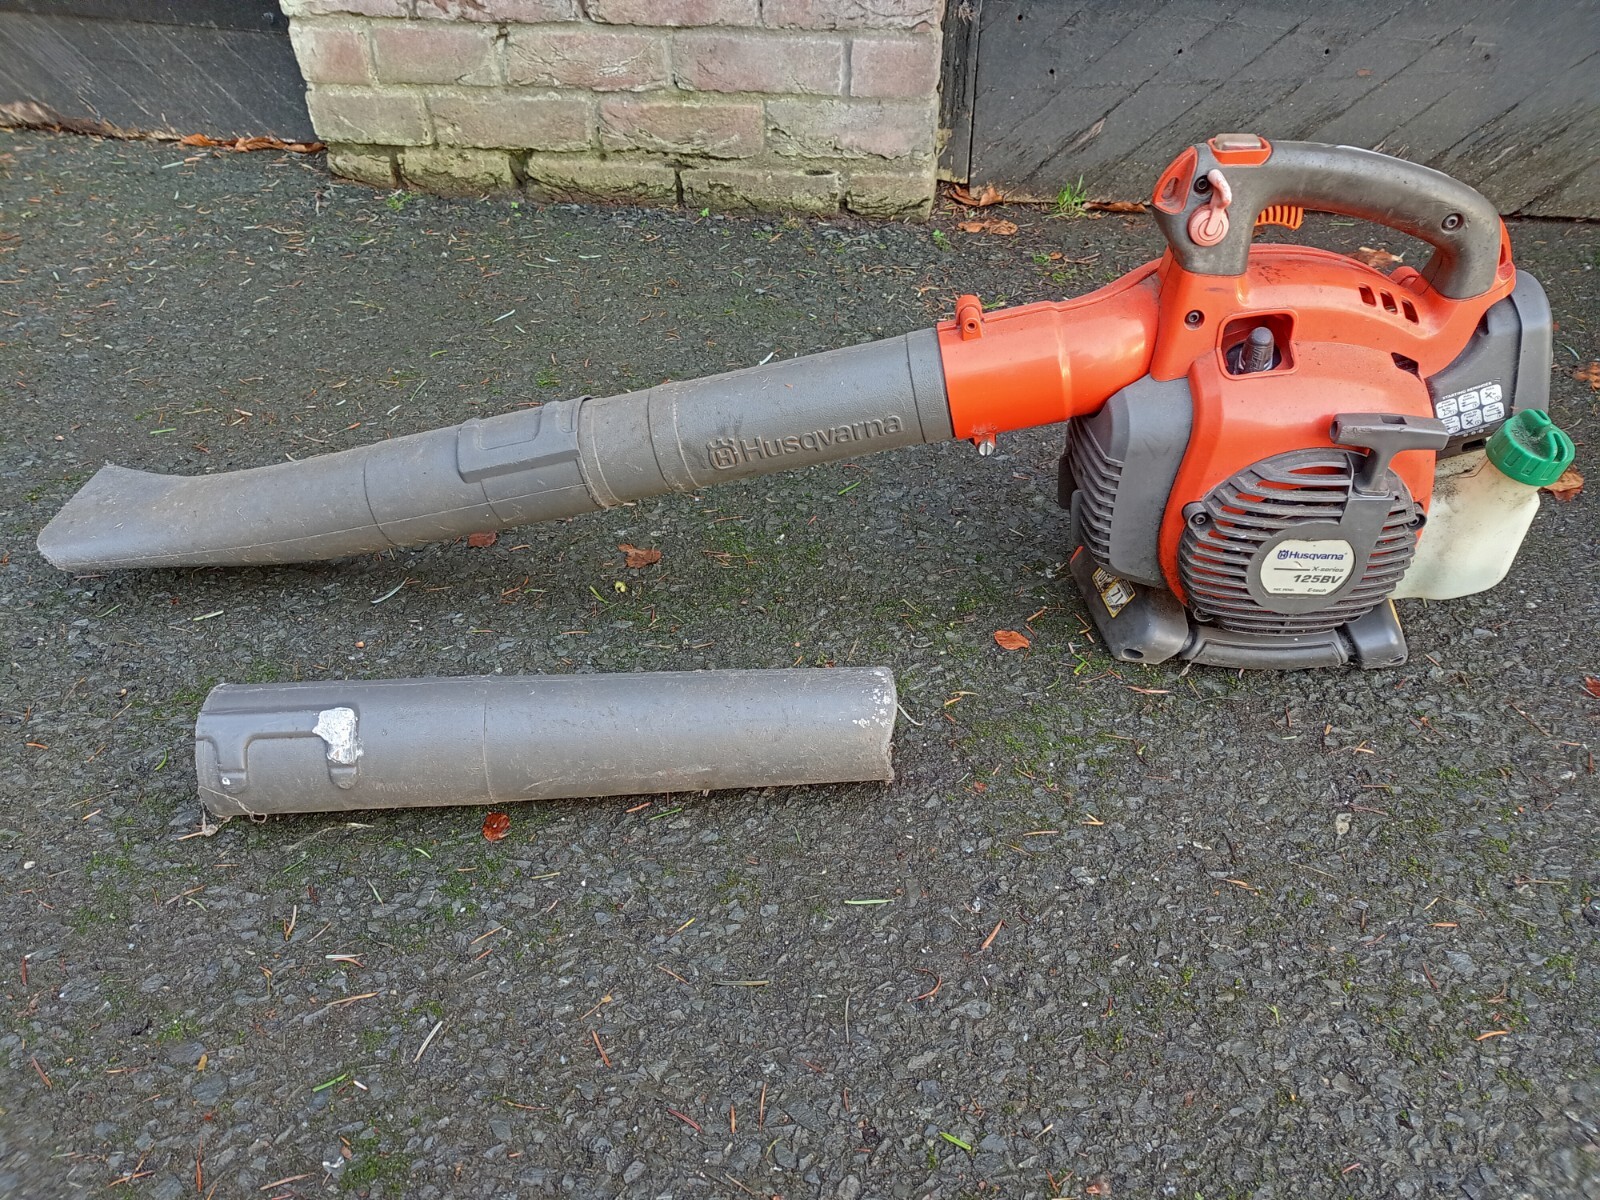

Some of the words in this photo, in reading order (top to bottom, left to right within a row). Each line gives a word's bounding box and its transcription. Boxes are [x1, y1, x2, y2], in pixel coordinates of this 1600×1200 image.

[739, 415, 904, 463] Husqvarna
[1289, 551, 1344, 561] Husqvarna
[1294, 574, 1343, 584] 125BV
